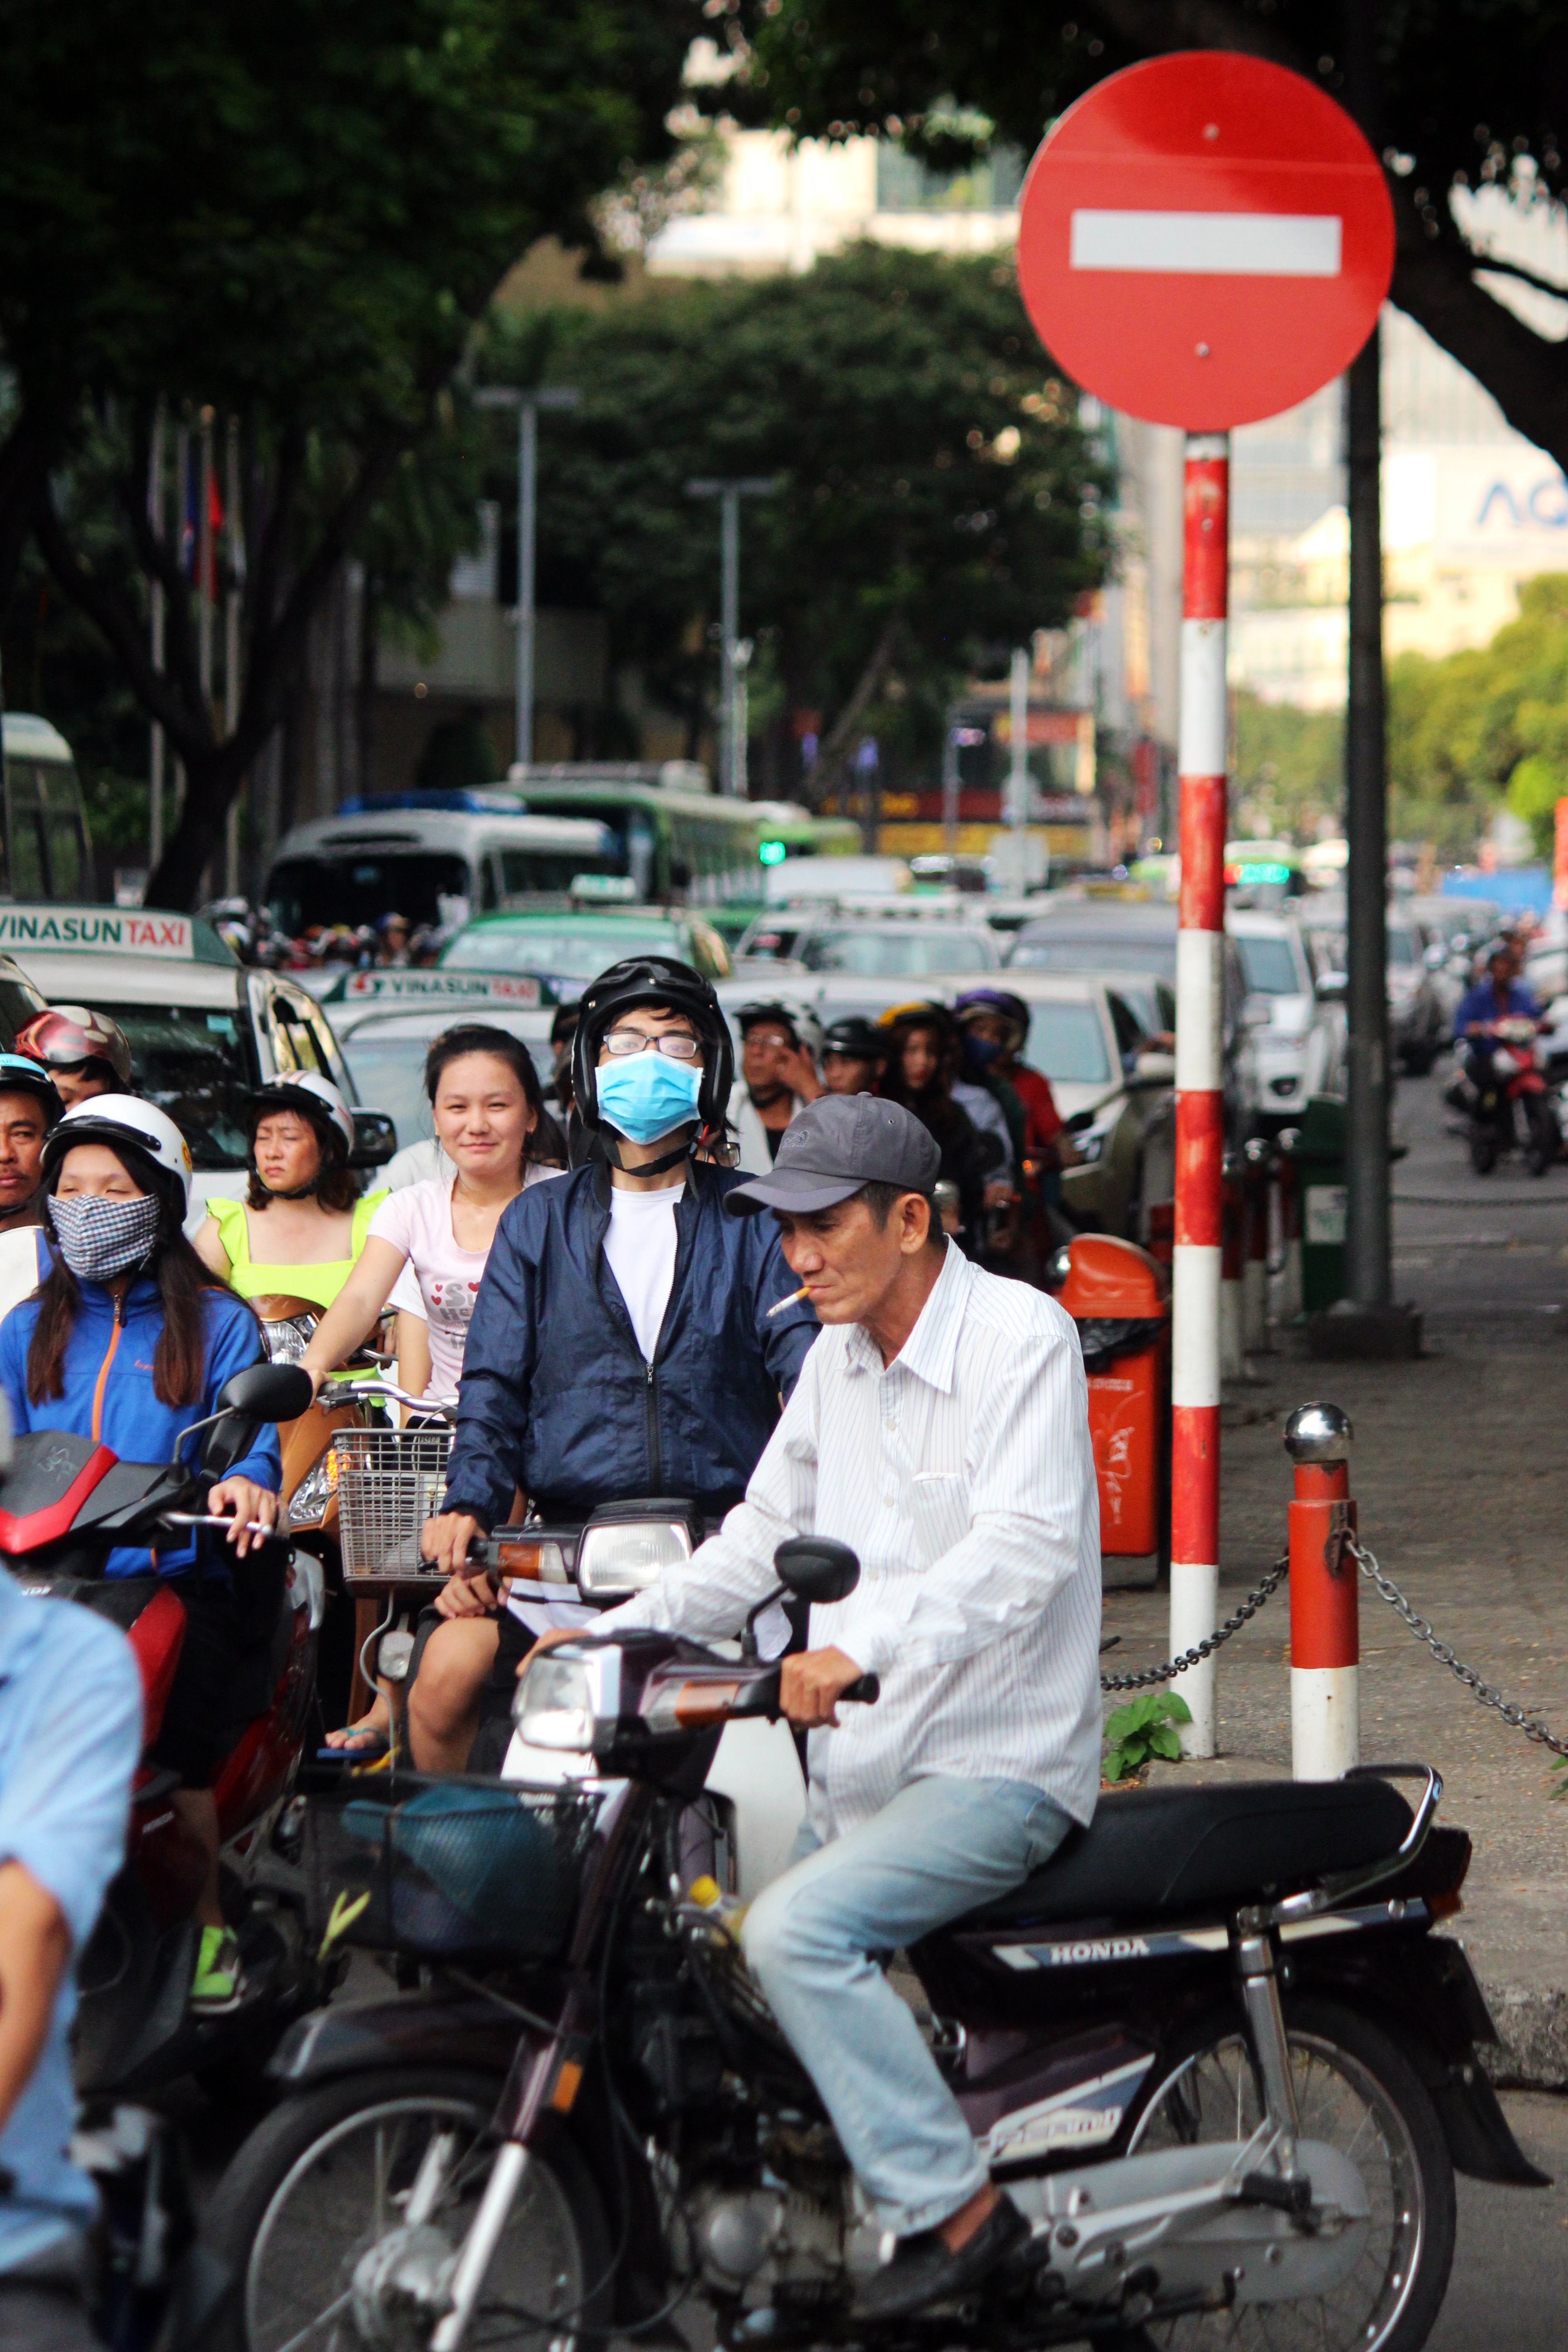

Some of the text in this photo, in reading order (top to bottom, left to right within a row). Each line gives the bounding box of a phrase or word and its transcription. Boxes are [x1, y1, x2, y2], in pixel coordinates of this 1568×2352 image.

[126, 919, 185, 945] TAXI
[392, 978, 489, 996] VINASUN
[1050, 1936, 1150, 1965] HONDA
